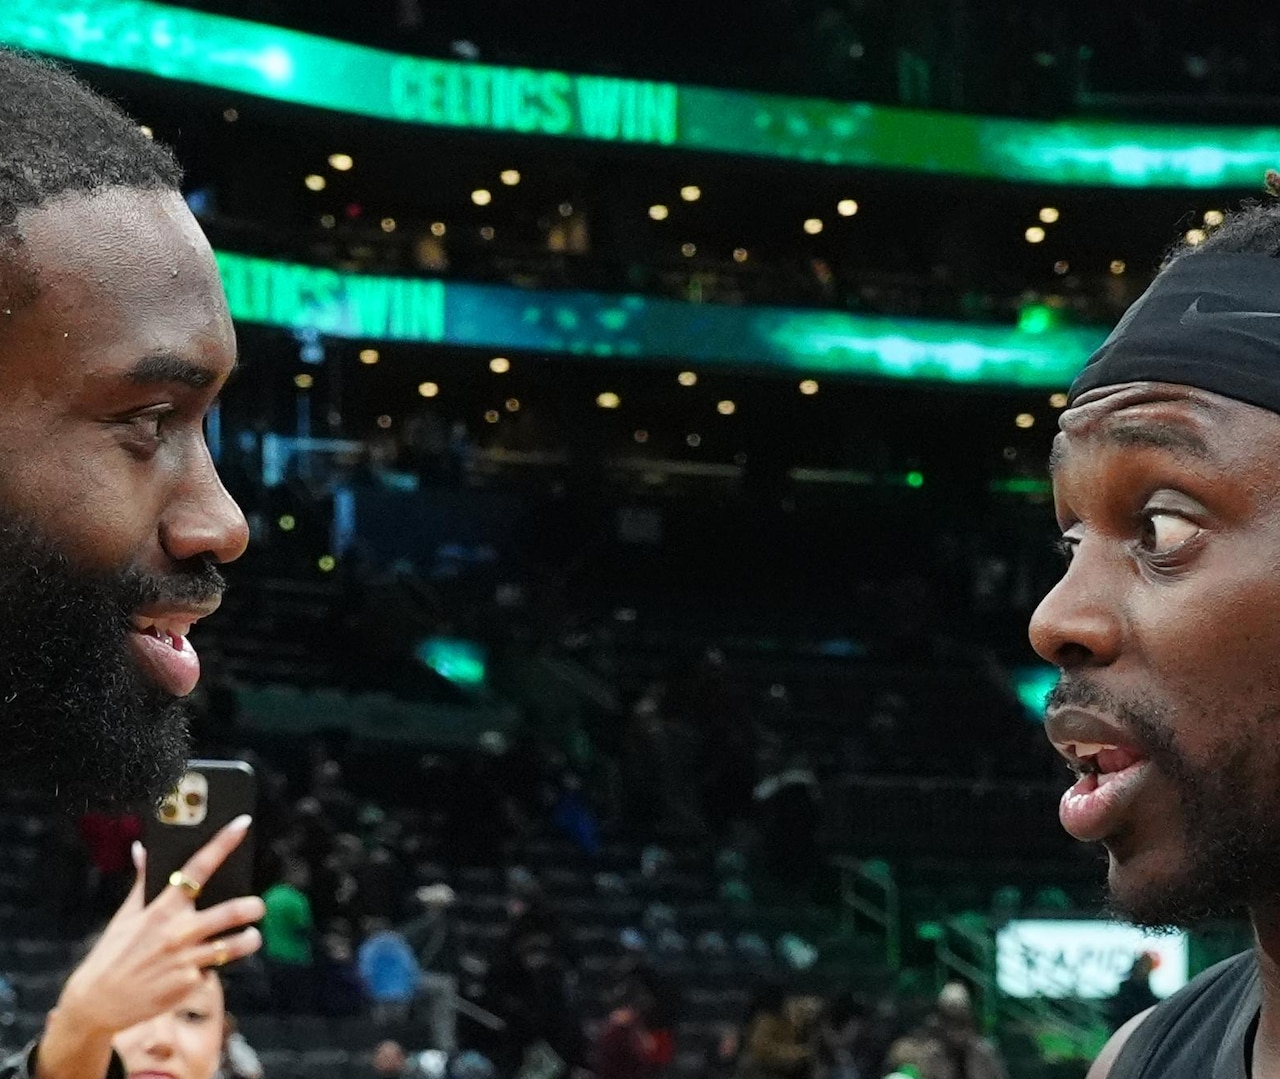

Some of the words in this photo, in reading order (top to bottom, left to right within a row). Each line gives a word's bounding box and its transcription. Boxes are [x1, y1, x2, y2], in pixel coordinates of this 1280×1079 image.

[391, 58, 571, 134] CELTICS
[577, 73, 678, 146] WIN
[345, 273, 445, 341] WIN
